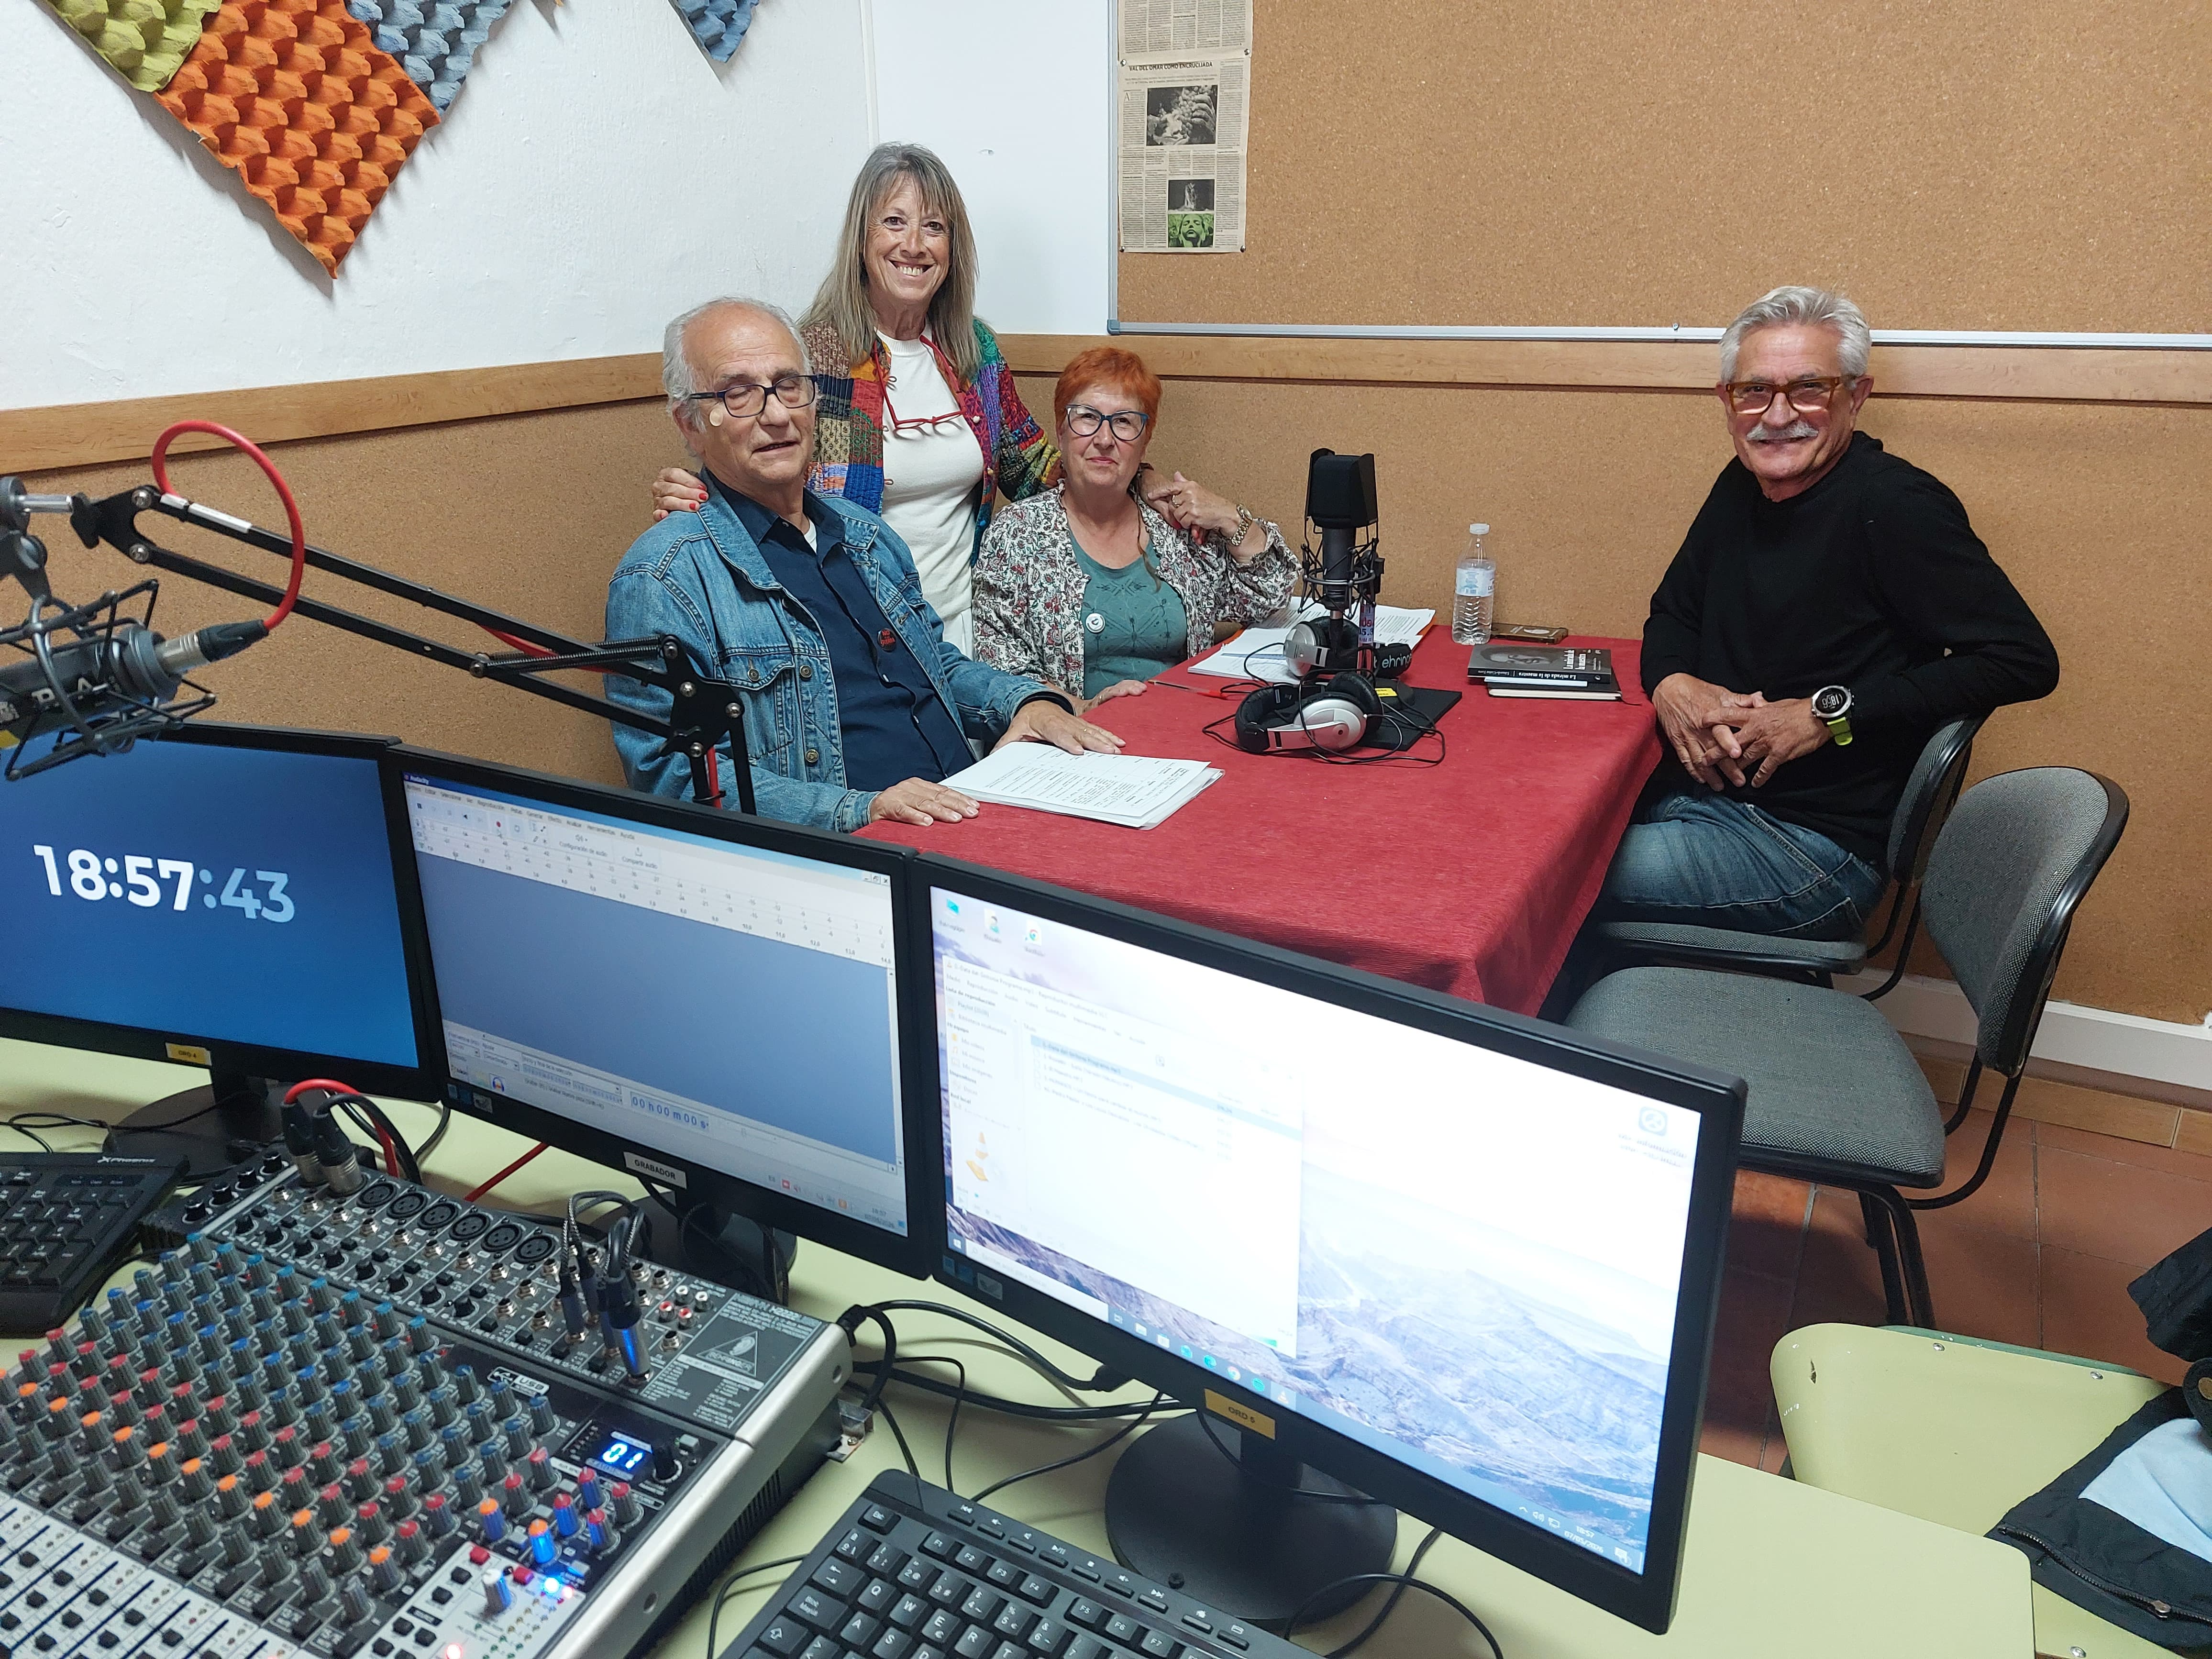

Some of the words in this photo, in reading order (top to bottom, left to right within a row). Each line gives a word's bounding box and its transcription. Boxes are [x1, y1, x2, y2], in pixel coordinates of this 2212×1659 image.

[33, 844, 295, 923] 18:57:43
[632, 1096, 645, 1108] 00
[649, 1102, 654, 1112] h
[657, 1105, 669, 1117] 00
[673, 1111, 681, 1120] m
[684, 1113, 697, 1125] 00
[700, 1121, 706, 1129] s
[634, 1159, 676, 1180] GRABADOR
[519, 1376, 546, 1390] USB
[1228, 1406, 1248, 1420] ORD
[964, 1552, 976, 1562] F2
[996, 1567, 1007, 1577] F3
[871, 1585, 882, 1596] Q
[1029, 1582, 1040, 1591] F4
[903, 1600, 917, 1612] W
[1079, 1604, 1091, 1615] F5
[852, 1618, 862, 1630] A
[934, 1615, 945, 1627] E
[1114, 1621, 1126, 1631] F6
[885, 1634, 896, 1645] S
[967, 1631, 978, 1643] R
[1150, 1637, 1163, 1647] F7
[1003, 1647, 1013, 1659] T
